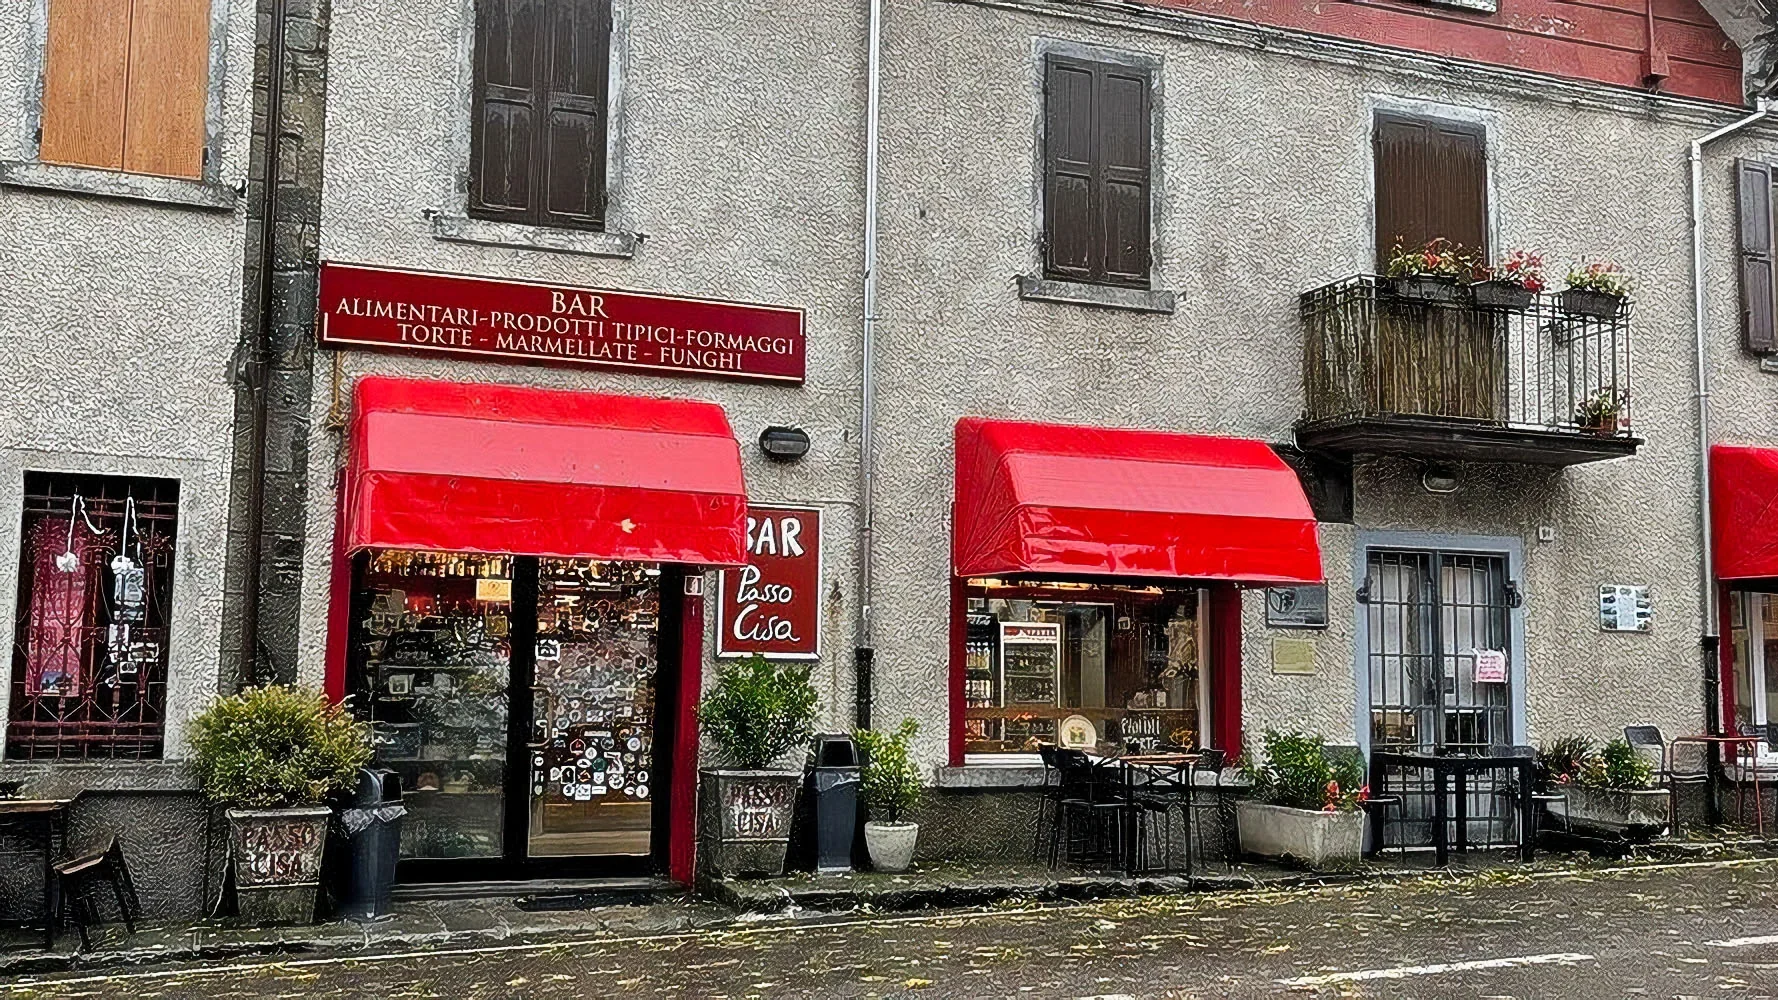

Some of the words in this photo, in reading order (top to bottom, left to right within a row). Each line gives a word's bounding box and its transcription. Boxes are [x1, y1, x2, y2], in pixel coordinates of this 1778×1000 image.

[550, 290, 609, 318] BAR
[336, 297, 604, 338] ALIMENTARI-PRODOTTI
[612, 321, 794, 355] TIPICI-FORMAGGI
[396, 323, 473, 347] TORTE
[495, 332, 637, 361] MARMELLATE
[660, 346, 743, 370] FUNGHI
[737, 564, 793, 604] Passo
[733, 604, 801, 642] Cisa
